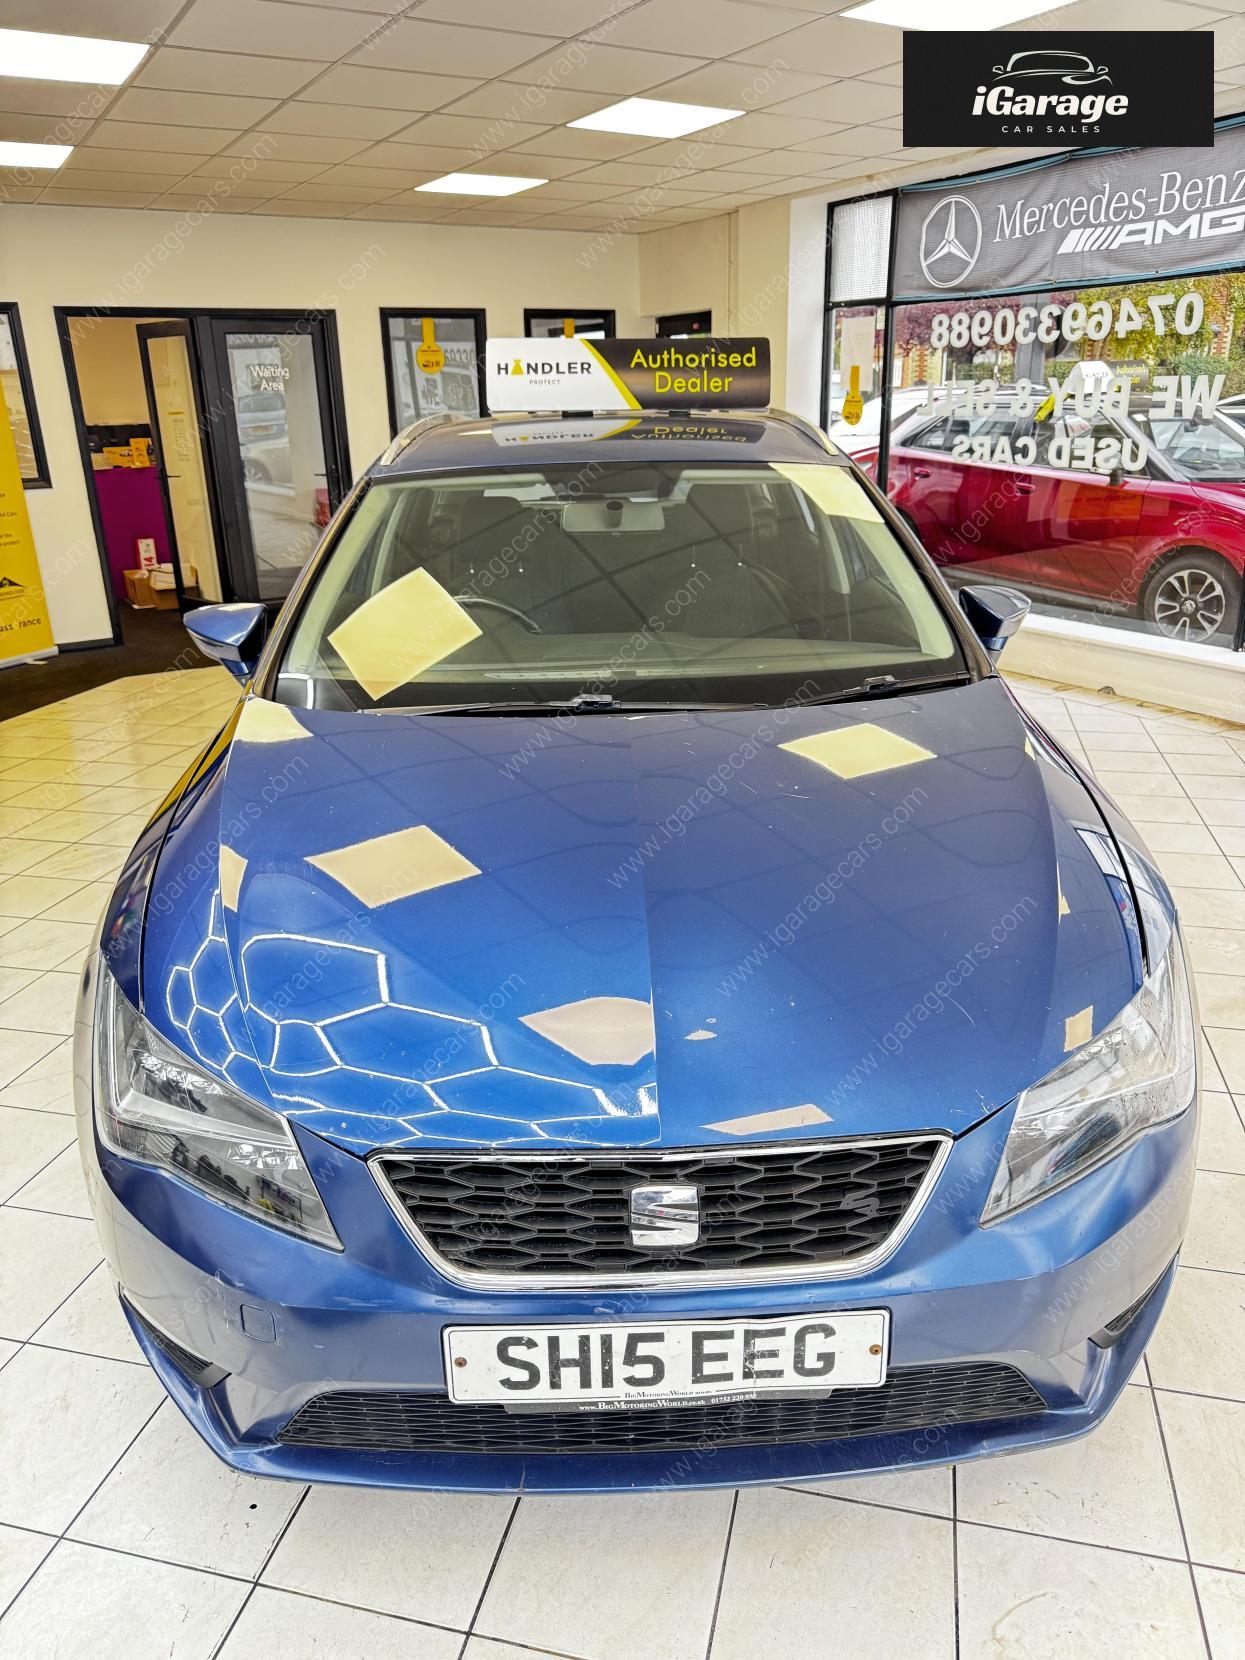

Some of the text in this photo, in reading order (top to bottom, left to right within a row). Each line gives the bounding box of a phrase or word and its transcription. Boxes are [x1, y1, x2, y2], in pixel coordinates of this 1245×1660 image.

[630, 348, 756, 369] Authorised
[250, 365, 290, 379] Waiting
[655, 372, 732, 393] Dealer
[260, 380, 284, 391] Area
[496, 1323, 838, 1391] SH15 EEG
